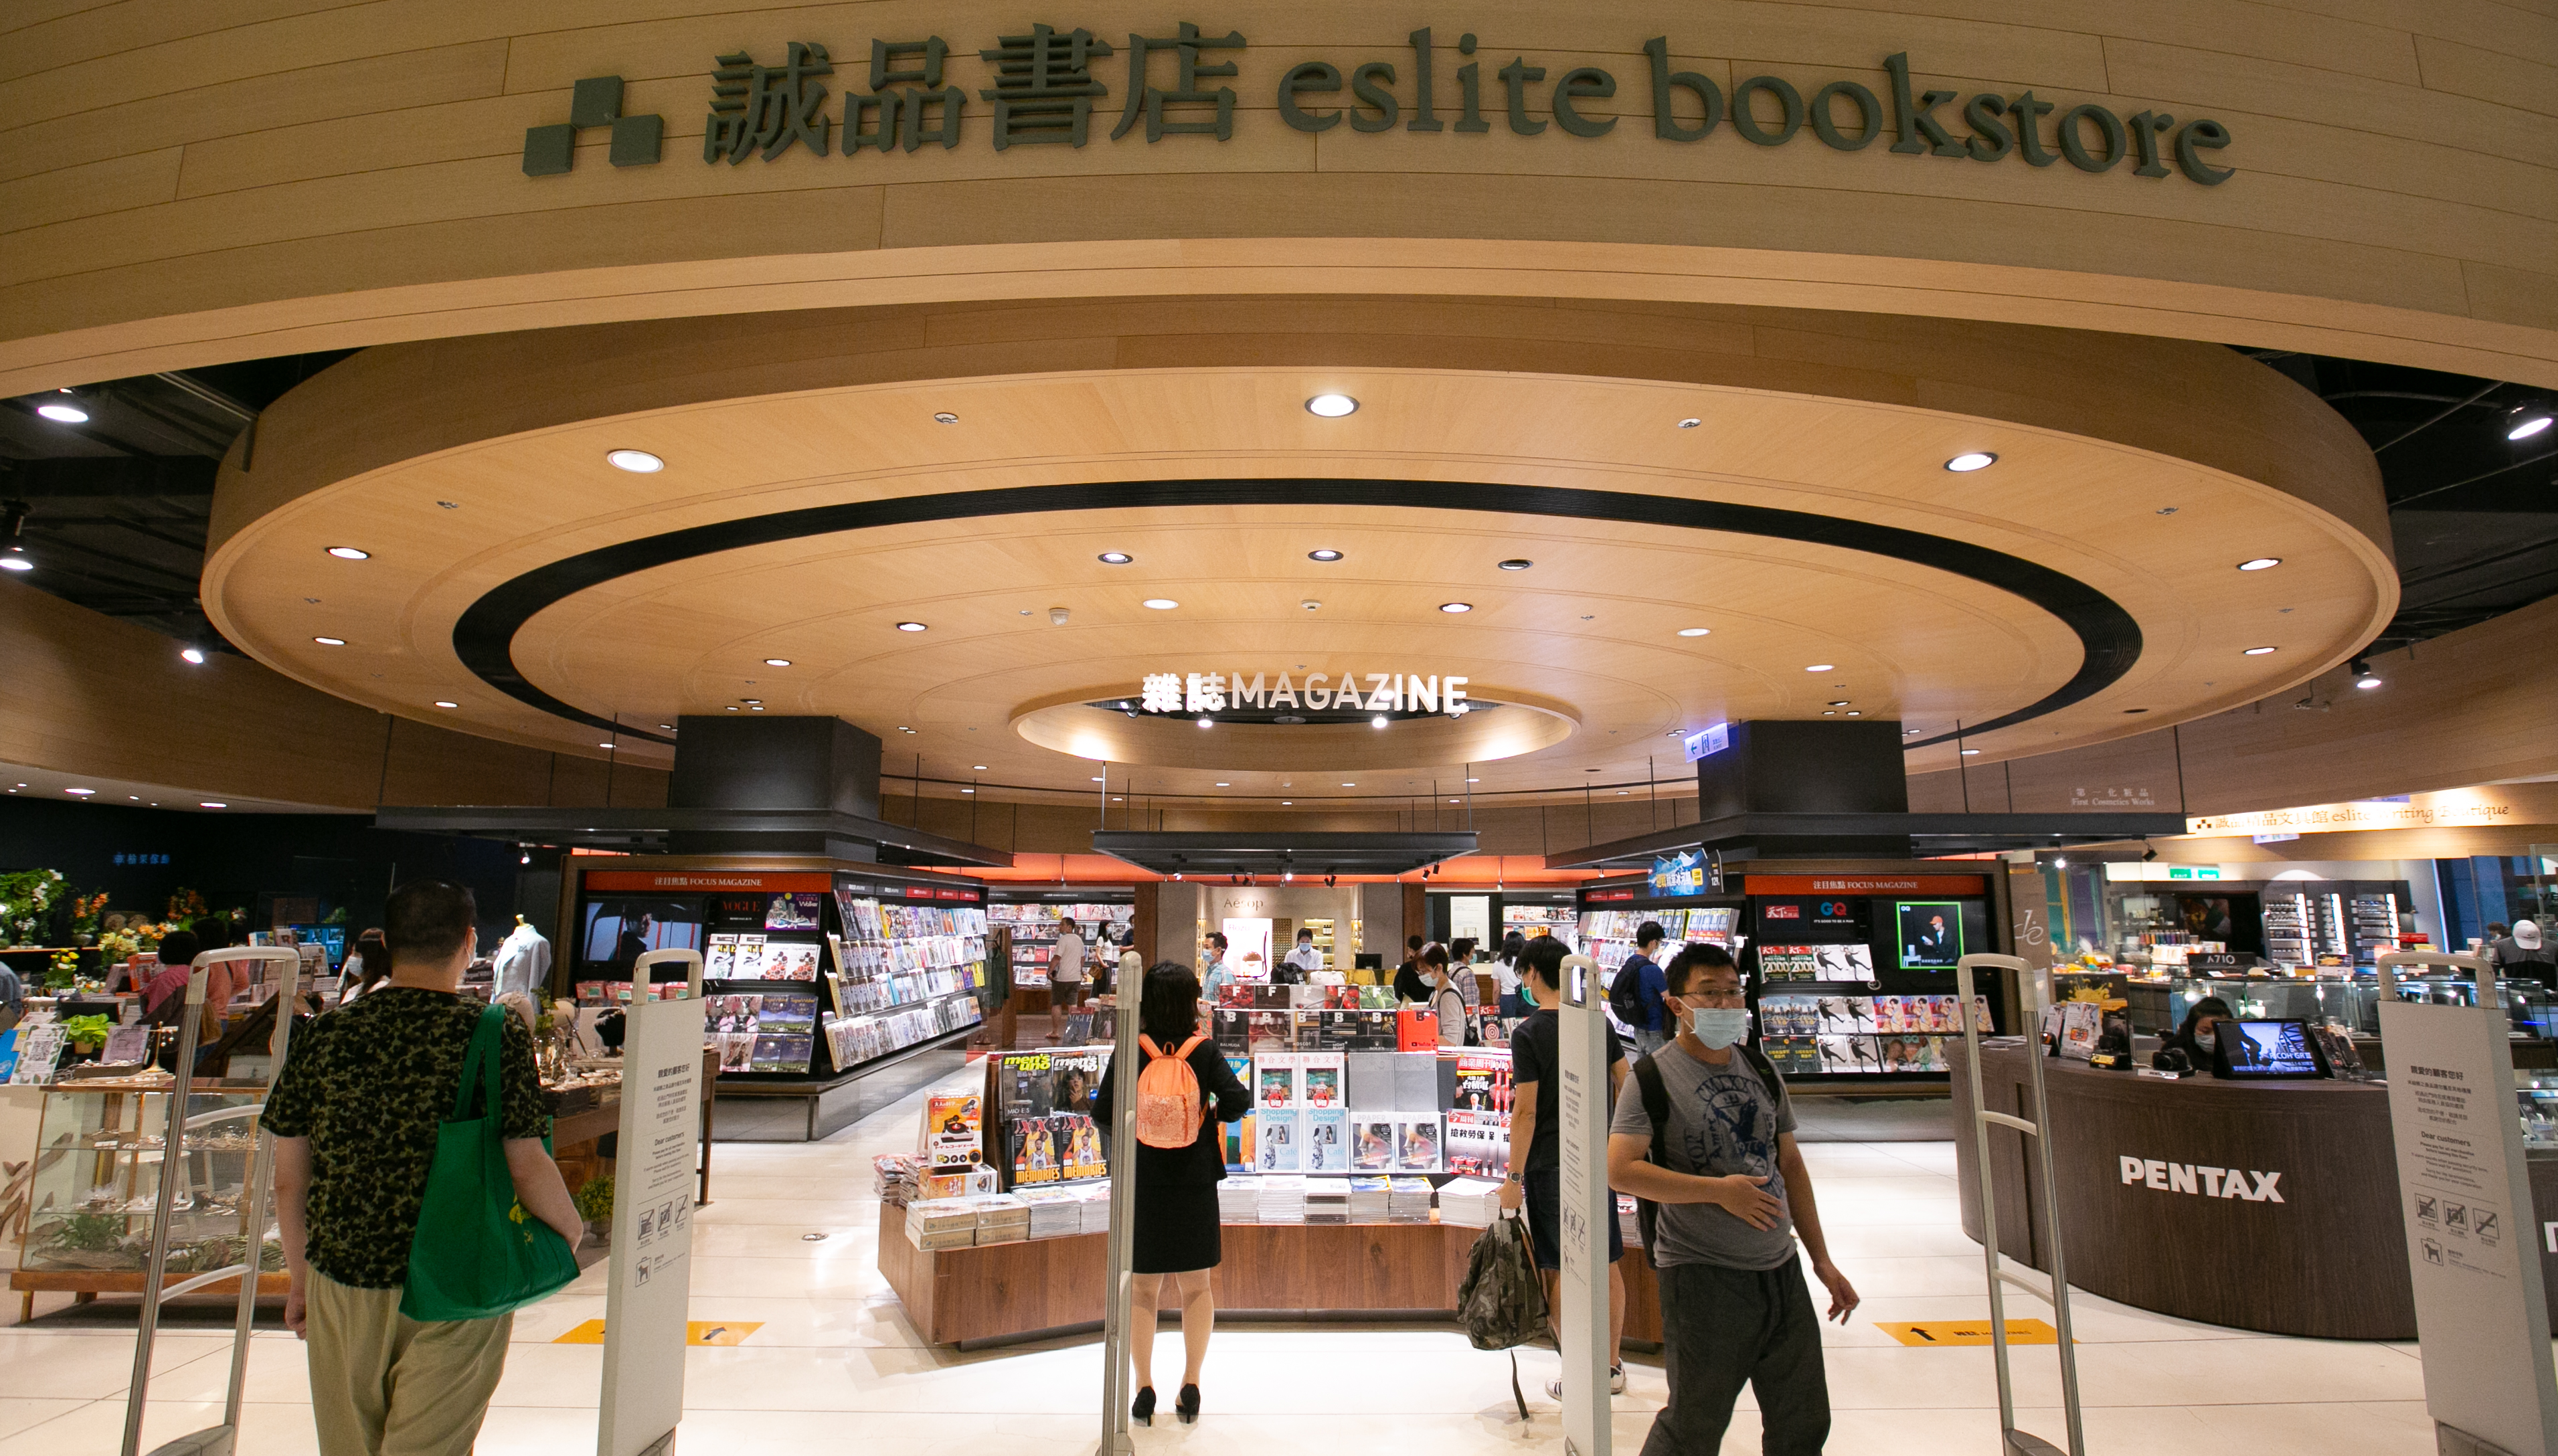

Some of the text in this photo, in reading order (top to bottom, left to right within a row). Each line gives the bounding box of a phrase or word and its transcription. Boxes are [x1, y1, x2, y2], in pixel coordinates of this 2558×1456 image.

[703, 21, 2237, 186] 誠品書店 eslite bookstore
[1142, 672, 1470, 714] 雜誌 MAGAZINE
[2332, 808, 2371, 822] eslite
[2440, 804, 2509, 823] Boutique
[655, 877, 762, 887] 注目焦點 FOCUS MAGAZINE
[1813, 881, 1918, 890] 注目焦點 FOCUS MAGAZINE
[723, 901, 761, 912] VOGUE
[1223, 898, 1264, 911] Aēsop
[1820, 902, 1847, 916] GQ
[1763, 962, 1790, 973] 2000
[1790, 962, 1816, 973] 2000
[1232, 986, 1241, 996] F
[1268, 986, 1276, 996] F
[1304, 986, 1312, 996] F
[1337, 986, 1346, 996] F
[1373, 988, 1381, 998] F
[1480, 1006, 1492, 1014] 天下
[1227, 1011, 1236, 1022] B
[1262, 1012, 1272, 1023] B
[1297, 1012, 1306, 1023] B
[1334, 1012, 1344, 1023] B
[1372, 1012, 1381, 1023] B
[1005, 1054, 1051, 1065] men's
[1054, 1055, 1098, 1067] men's
[1258, 1055, 1296, 1064] 聯合文學
[1302, 1055, 1341, 1064] 聯合文學
[1458, 1058, 1493, 1069] 商業周刊
[658, 1063, 690, 1078] 親愛的顧客您好
[1019, 1061, 1051, 1071] uno
[2411, 1065, 2464, 1081] 親愛的顧客您好
[1261, 1108, 1297, 1117] Shopping
[1308, 1108, 1344, 1117] Shopping
[1448, 1111, 1474, 1123] 今周刊
[655, 1131, 685, 1146] Dear customers
[1450, 1127, 1485, 1140] 搶救勞保
[2421, 1131, 2471, 1147] Dear customers
[1279, 1147, 1297, 1156] Café
[1327, 1147, 1345, 1156] Café
[1354, 1156, 1373, 1164] TREASURE
[1015, 1166, 1060, 1182] MEMORIES
[1063, 1164, 1107, 1179] MEMORIES
[2120, 1155, 2286, 1203] PENTAX
